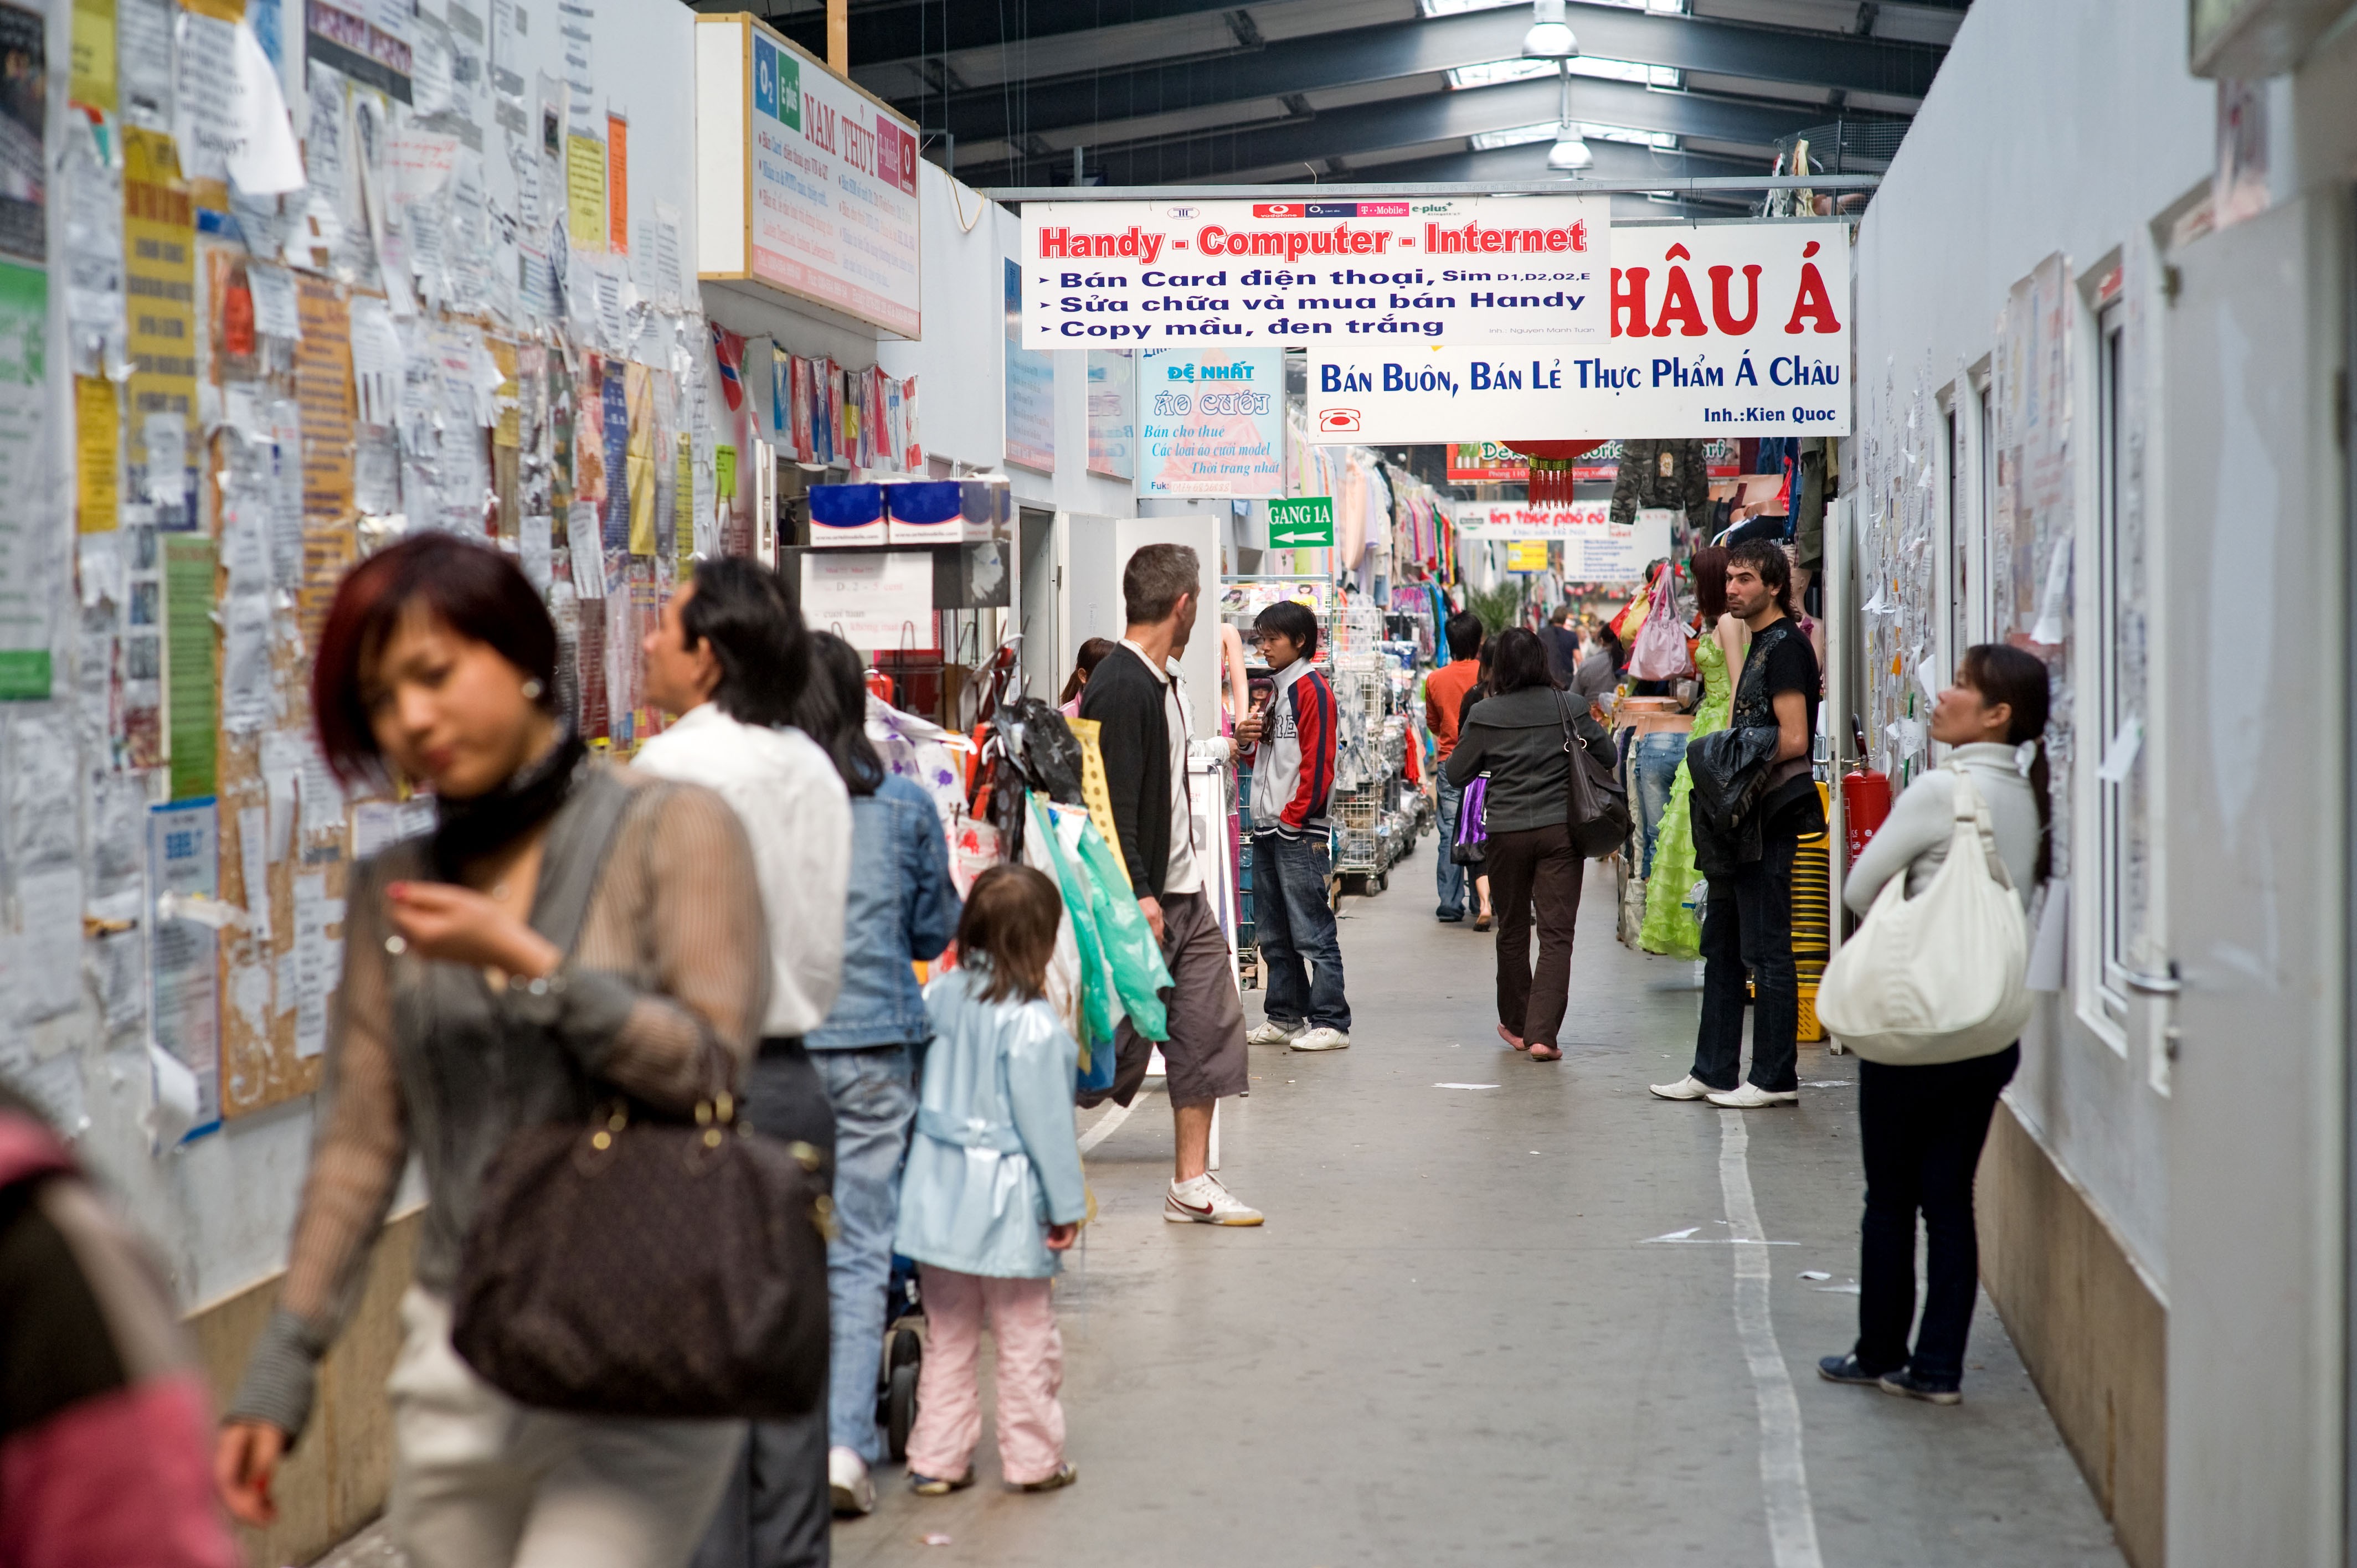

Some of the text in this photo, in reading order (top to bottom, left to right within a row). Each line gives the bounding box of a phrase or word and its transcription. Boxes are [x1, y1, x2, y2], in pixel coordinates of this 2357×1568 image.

[804, 93, 875, 177] NAM THỦY
[1039, 226, 1166, 265] Handy
[1197, 224, 1393, 263] Computer
[1425, 219, 1587, 254] Internet
[1061, 272, 1126, 287] Bán
[1142, 271, 1226, 287] Card
[1241, 270, 1315, 290] điện
[1330, 269, 1434, 288] thoại,
[1443, 271, 1490, 281] Sim
[1784, 241, 1841, 334] Á
[1061, 292, 1585, 312] Sửa chữa và mua bán Handy
[1061, 322, 1151, 339] Copy
[1268, 318, 1331, 334] đen
[1346, 314, 1443, 336] trắng
[1168, 361, 1254, 383] ĐỆ NHẤT
[1735, 349, 1758, 386] Á
[1154, 389, 1270, 416] ÁO CƯỚI
[1705, 407, 1835, 424] Inh.:Kien Quoc
[1144, 425, 1169, 438] Bán
[1173, 425, 1195, 438] cho
[1152, 443, 1172, 457] Các
[1198, 443, 1210, 456] áo
[1238, 442, 1270, 456] model
[1221, 464, 1250, 476] trang
[1151, 481, 1170, 490] Fuk:
[1269, 505, 1331, 525] GANG 1A
